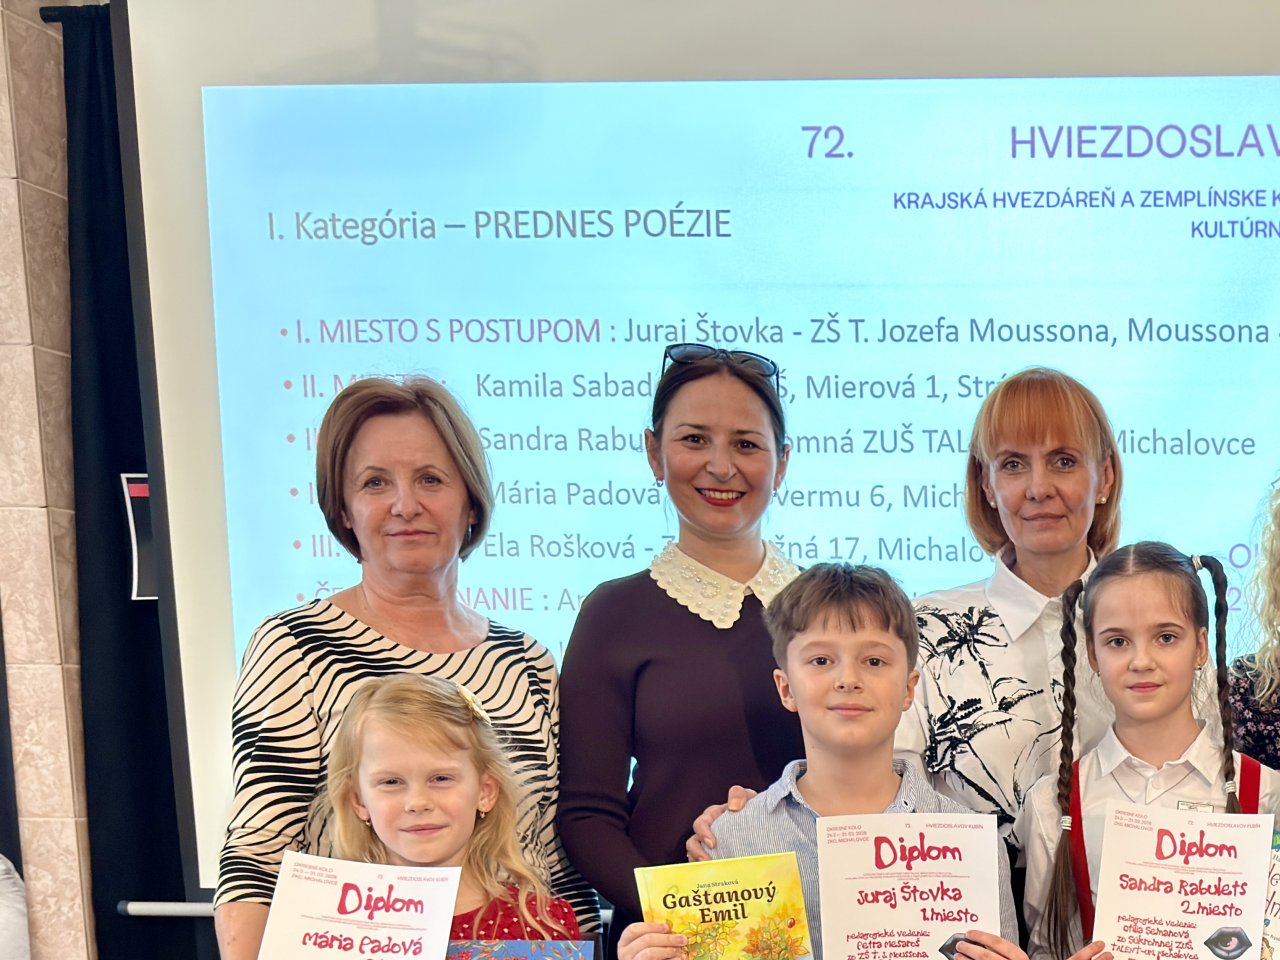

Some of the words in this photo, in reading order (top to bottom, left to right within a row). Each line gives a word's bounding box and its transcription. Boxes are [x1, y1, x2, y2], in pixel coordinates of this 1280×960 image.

[801, 125, 855, 159] 72.
[893, 187, 988, 210] KRAJSKÁ
[993, 186, 1116, 209] HVEZDÁREŇ
[1120, 191, 1135, 208] A
[1140, 187, 1267, 208] ZEMPLÍNSKE
[295, 209, 437, 246] Kategória
[475, 210, 614, 239] PREDNES
[625, 201, 731, 238] POÉZIE
[319, 319, 418, 343] MIESTO
[427, 319, 441, 343] S
[450, 319, 601, 343] POSTUPOM
[624, 317, 686, 344] Juraj
[695, 312, 784, 343] Štovka
[810, 312, 840, 343] ZŠ
[849, 319, 869, 343] T.
[877, 316, 959, 343] Jozefa
[969, 318, 1118, 346] Moussona,
[1128, 317, 1270, 343] Moussona
[476, 372, 564, 398] Kamila
[572, 372, 652, 398] Sabad
[806, 373, 916, 399] Mierová
[925, 374, 948, 403] 1,
[479, 426, 568, 451] Sandra
[863, 423, 914, 453] ZUŠ
[870, 485, 893, 513] 6,
[484, 533, 520, 558] Ela
[530, 532, 635, 559] Rošková
[829, 537, 867, 566] 17,
[874, 832, 962, 870] Diplom
[1155, 828, 1238, 865] Diplom
[663, 881, 776, 910] Gaštanový
[857, 888, 897, 909] Juraj
[900, 881, 963, 902] Štovka
[1119, 873, 1174, 894] Sandra
[1178, 877, 1248, 897] Rabulets
[337, 883, 424, 920] Diplom
[699, 903, 749, 924] Emil
[302, 931, 354, 951] Mária
[359, 935, 424, 956] Padová
